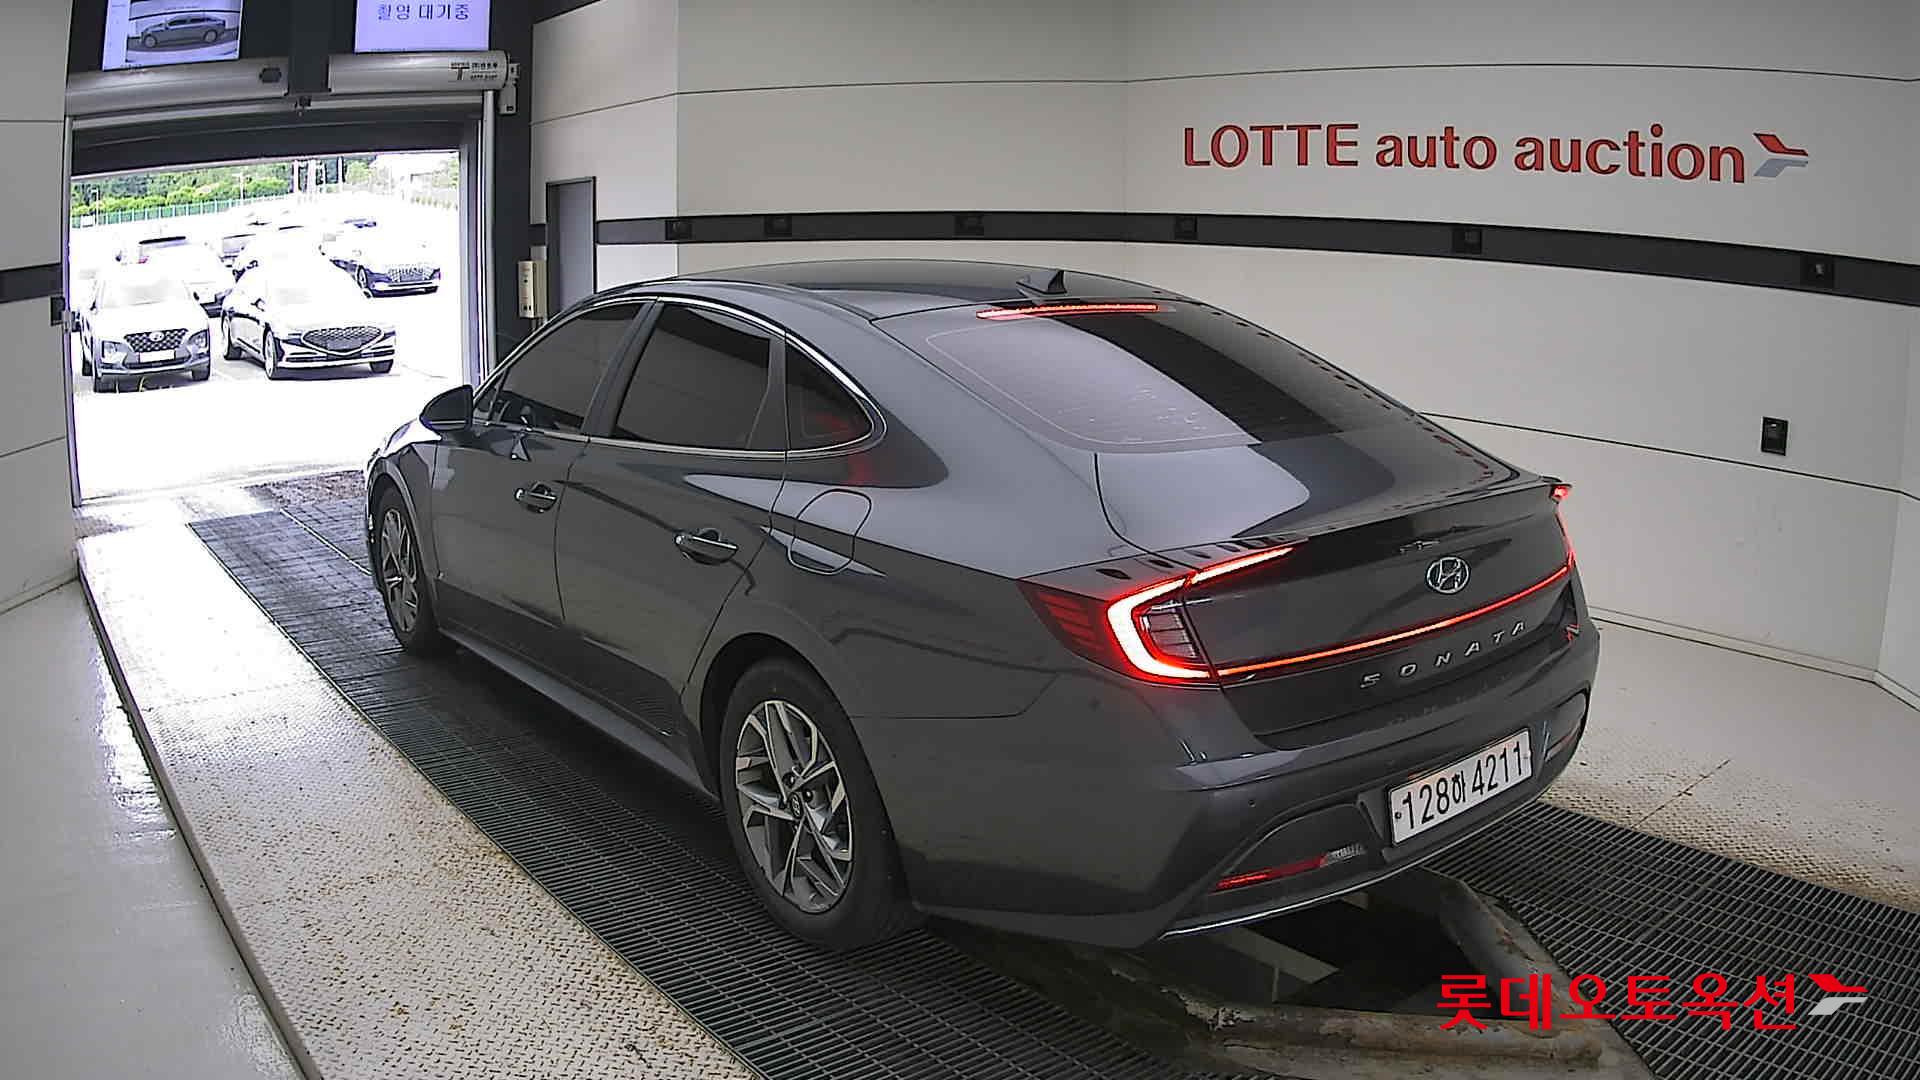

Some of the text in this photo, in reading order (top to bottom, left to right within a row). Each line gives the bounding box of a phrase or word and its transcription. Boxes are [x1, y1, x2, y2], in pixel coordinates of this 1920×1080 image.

[418, 3, 469, 20] 대기중
[1184, 123, 1746, 184] LOTTE auto auction
[1360, 620, 1526, 688] SONATA
